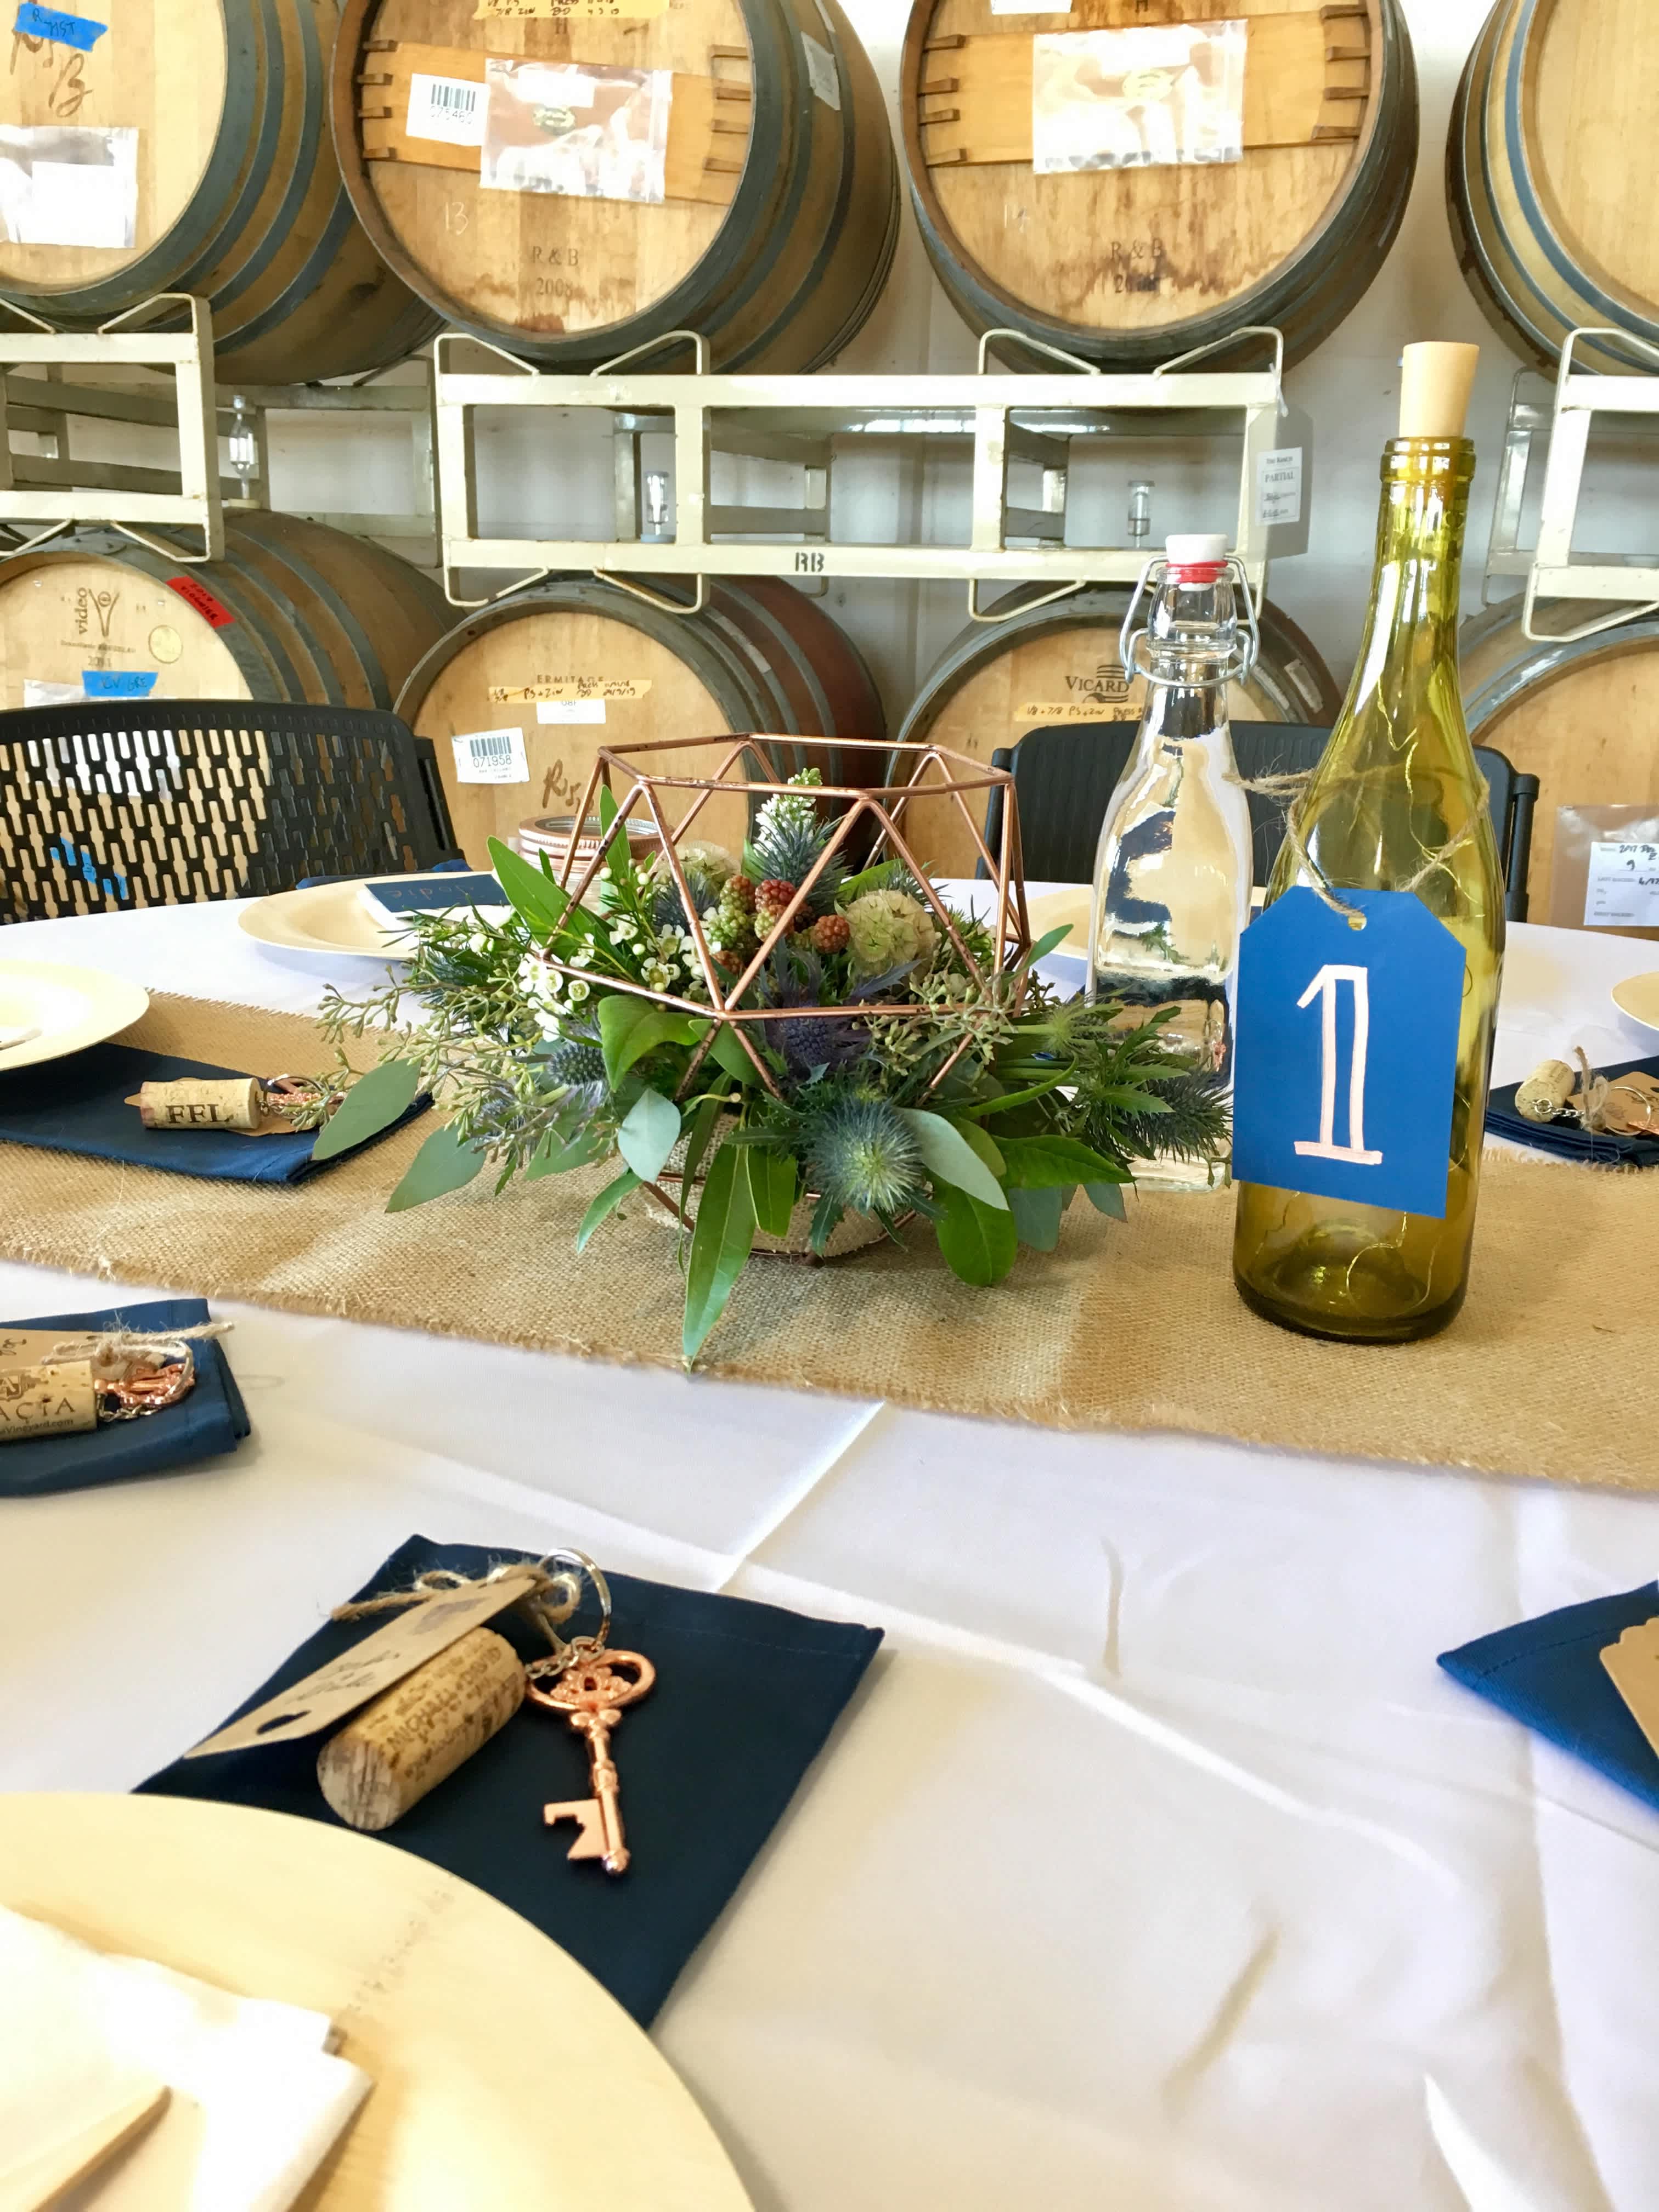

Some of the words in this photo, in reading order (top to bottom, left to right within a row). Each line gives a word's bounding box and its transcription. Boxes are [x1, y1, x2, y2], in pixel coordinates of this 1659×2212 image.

[532, 245, 543, 264] R
[567, 249, 579, 266] B
[1265, 471, 1295, 483] PARTIAL
[795, 552, 825, 572] RB
[1065, 675, 1130, 693] VICARD
[473, 754, 512, 768] 071958
[1294, 964, 1383, 1165] 1
